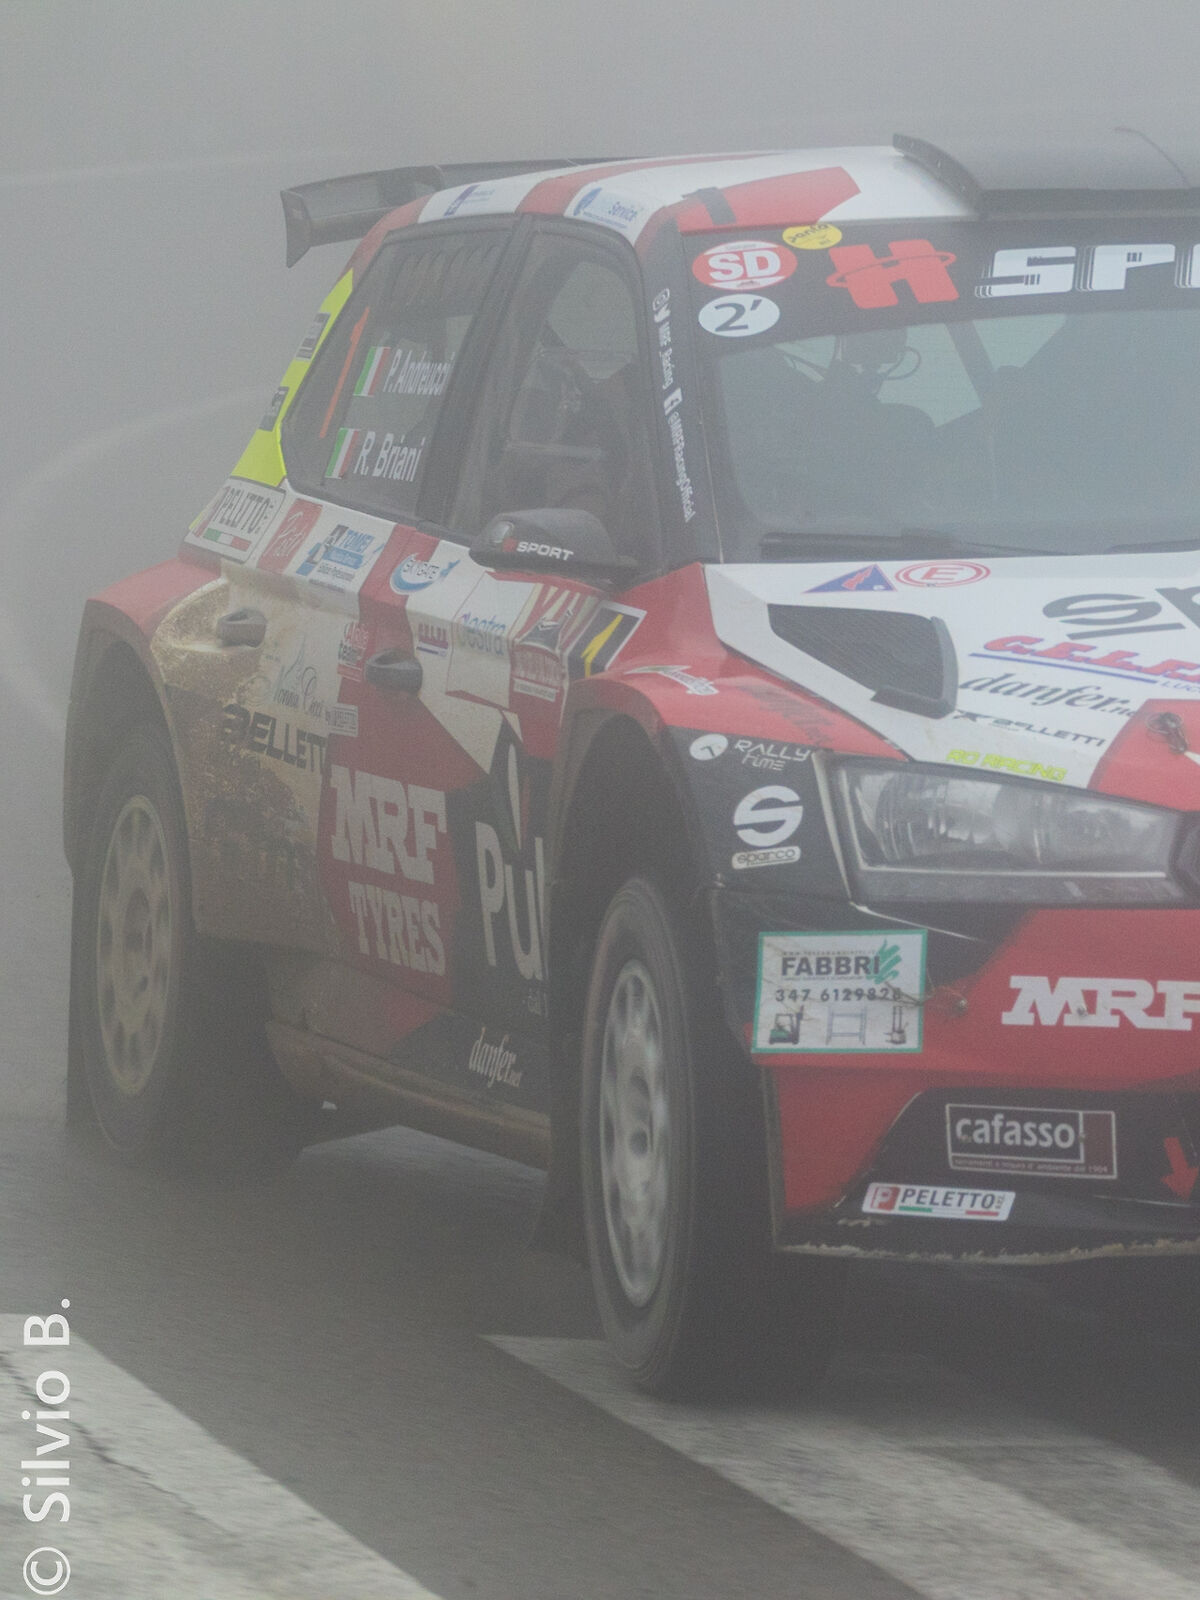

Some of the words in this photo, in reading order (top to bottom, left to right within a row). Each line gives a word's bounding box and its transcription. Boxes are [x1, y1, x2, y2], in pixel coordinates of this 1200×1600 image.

[708, 250, 781, 282] SD
[827, 239, 960, 309] H
[372, 432, 426, 482] Briani
[516, 541, 575, 561] SPORT
[735, 739, 812, 762] RALLY
[331, 764, 447, 885] MRF
[348, 880, 446, 977] TYRES
[781, 956, 880, 976] FABBRI
[775, 988, 811, 1002] 347
[956, 1113, 1075, 1149] cafasso
[900, 1188, 995, 1209] PELETTO
